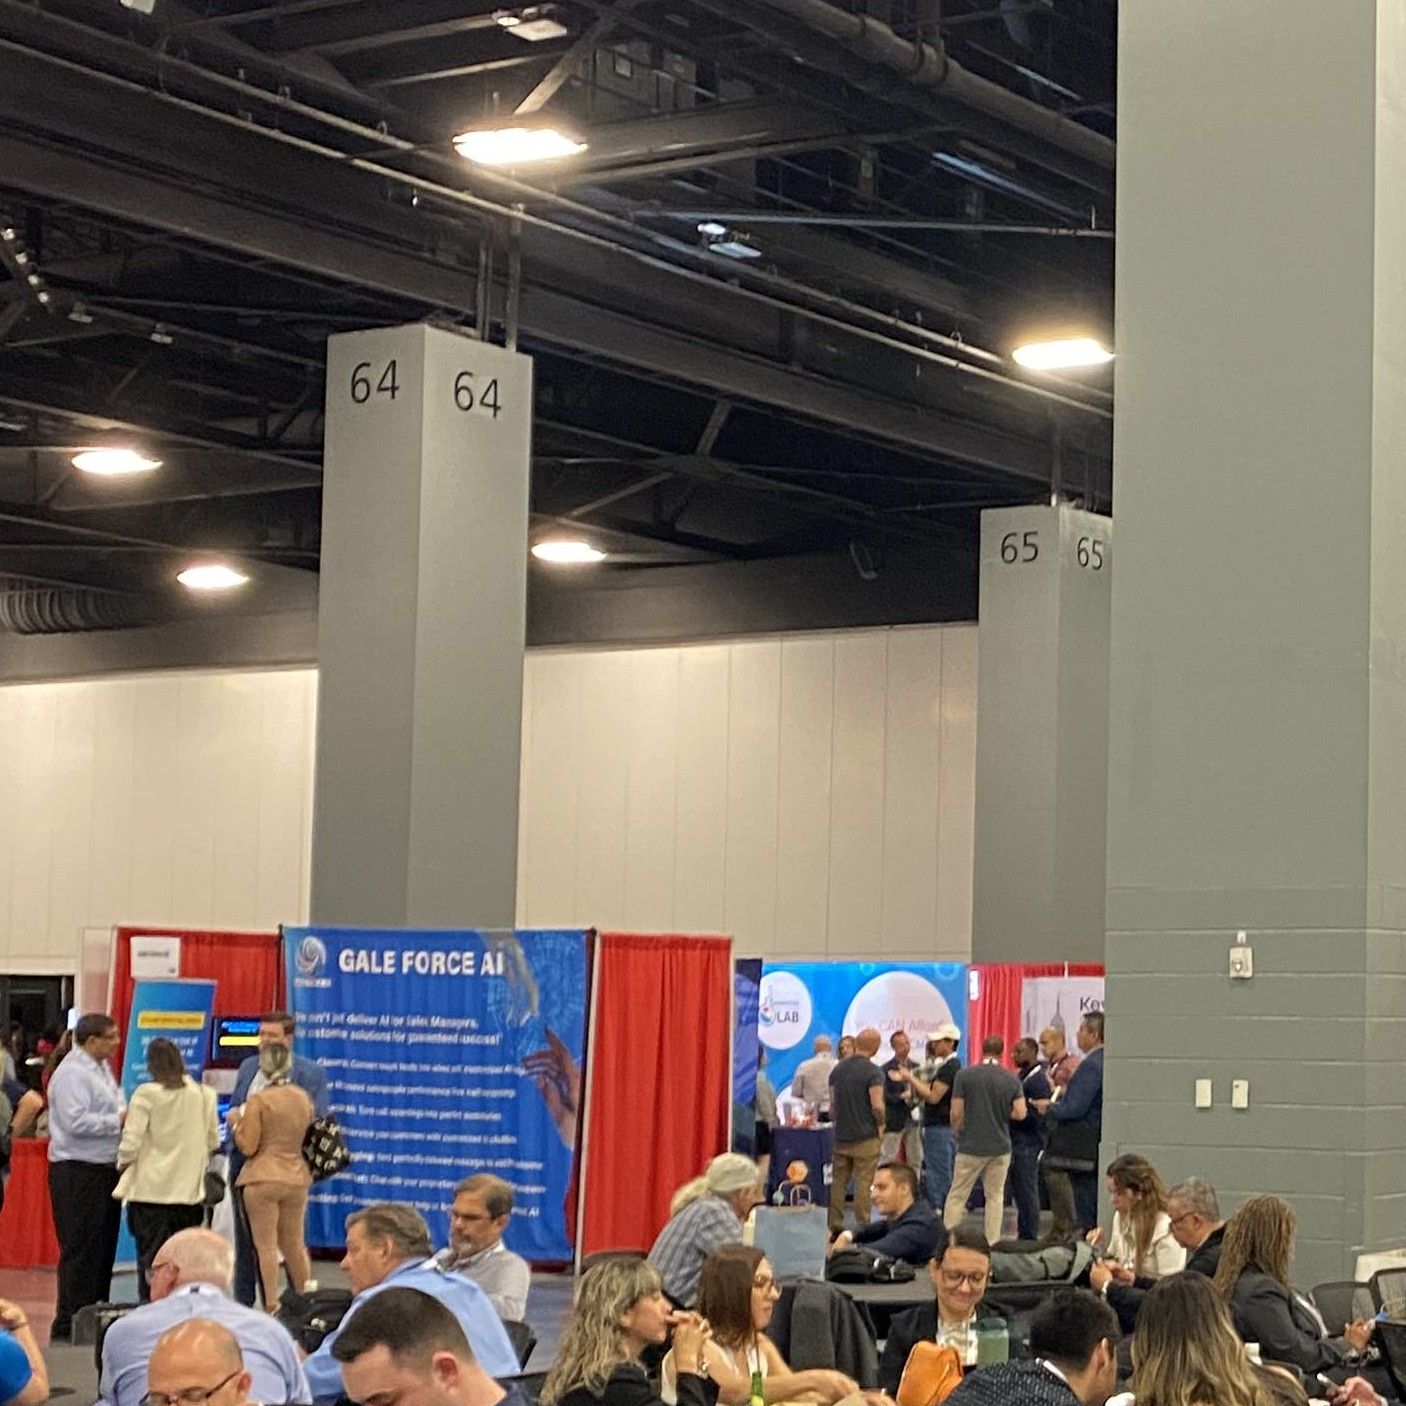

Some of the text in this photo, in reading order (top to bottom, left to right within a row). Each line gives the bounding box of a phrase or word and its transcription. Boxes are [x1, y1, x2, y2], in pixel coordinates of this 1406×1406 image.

[350, 359, 400, 404] 64
[454, 371, 501, 418] 64
[1001, 531, 1039, 564] 65
[1077, 536, 1103, 570] 65
[338, 948, 504, 976] GALE FORCE AI
[776, 1011, 799, 1023] LAB
